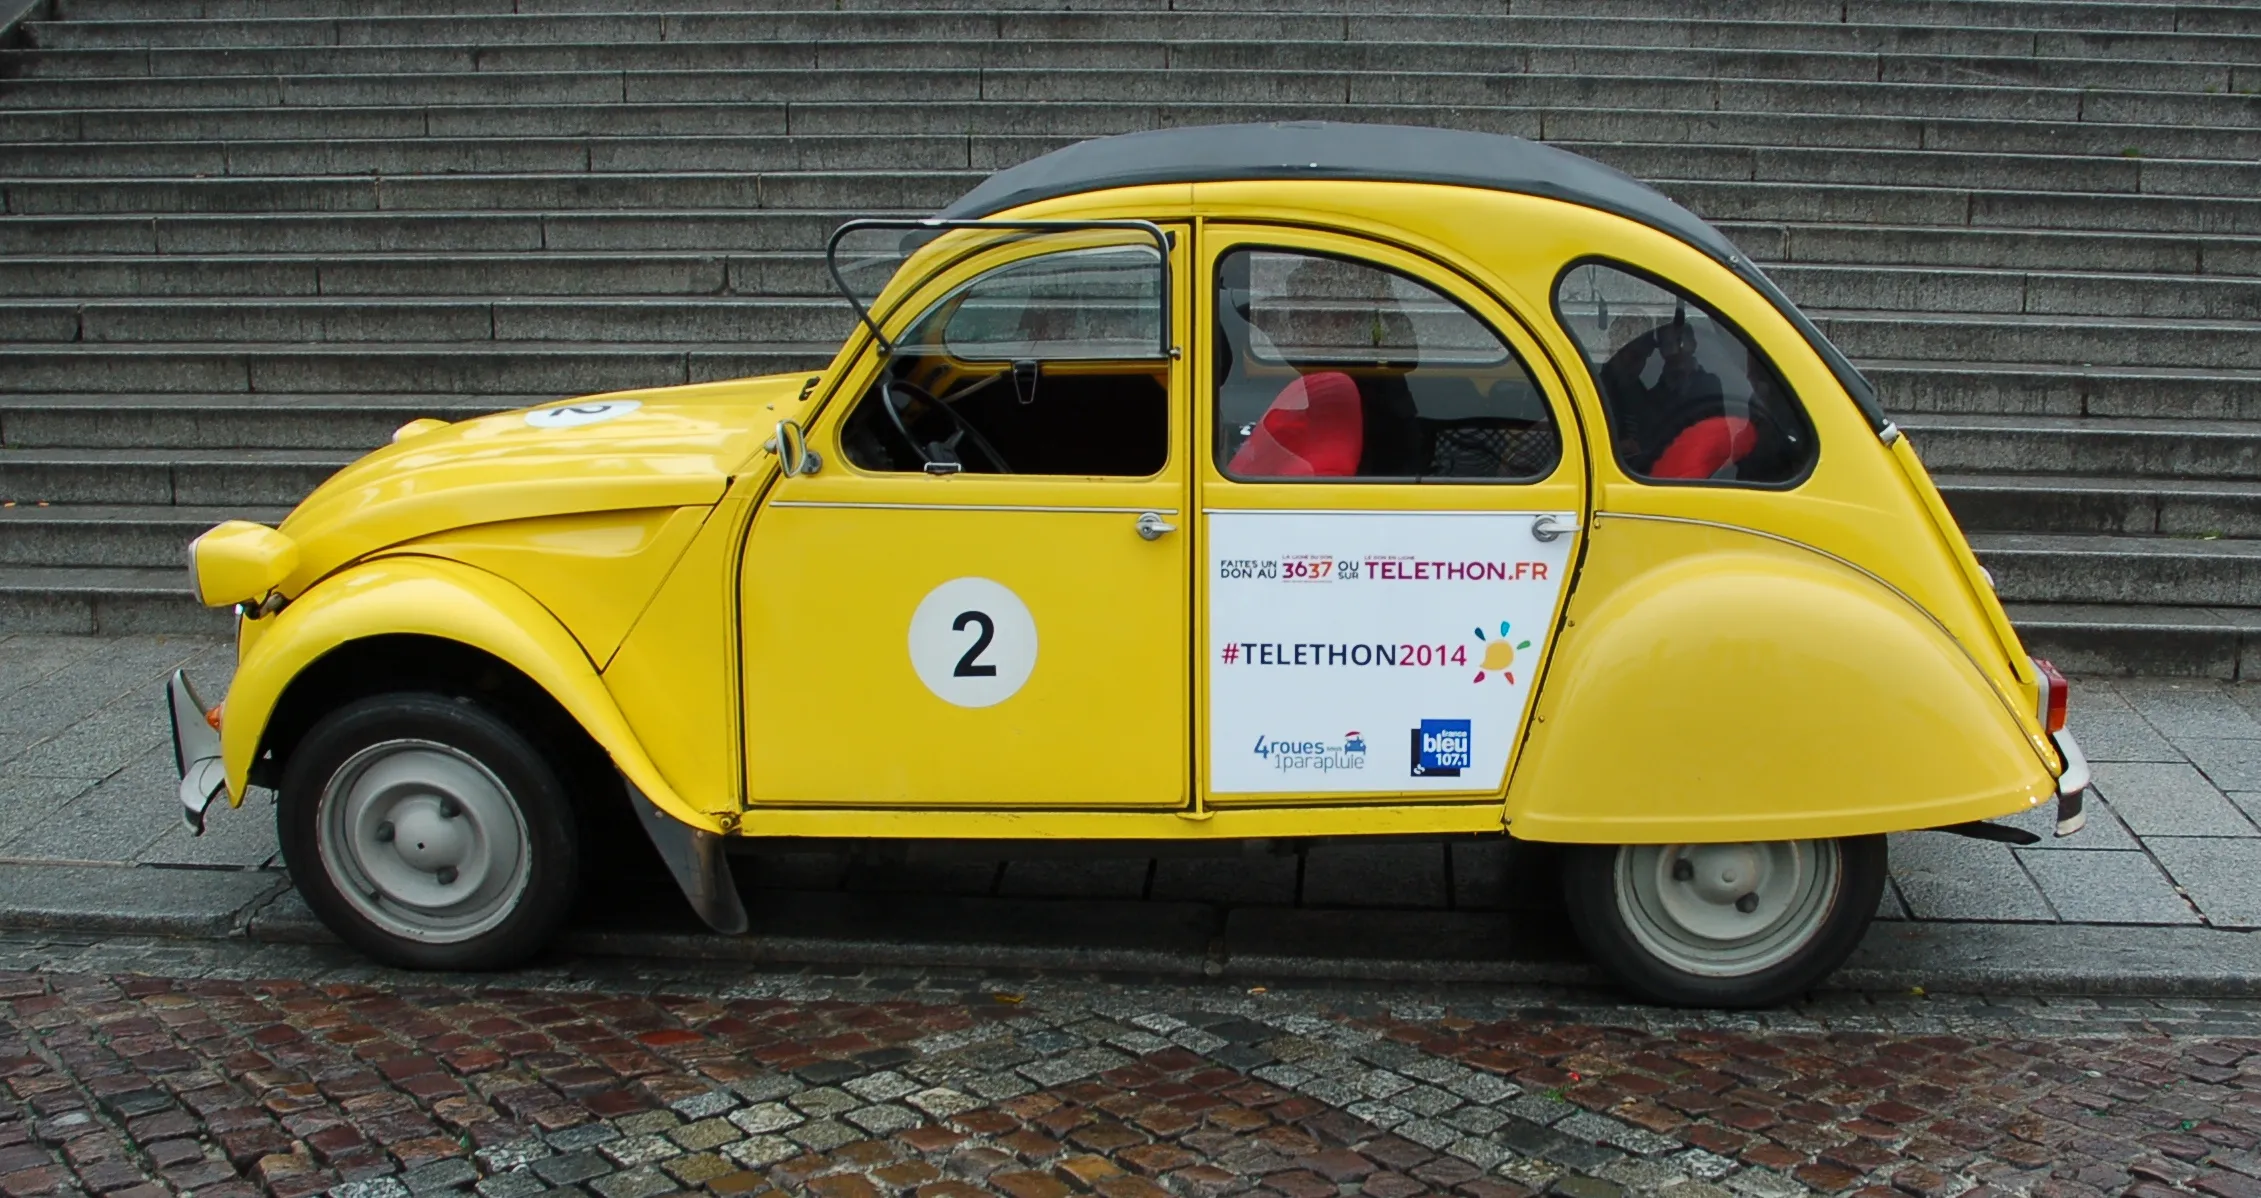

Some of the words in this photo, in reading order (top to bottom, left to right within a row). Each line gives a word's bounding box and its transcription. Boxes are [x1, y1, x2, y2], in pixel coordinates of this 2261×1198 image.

[1220, 560, 1258, 568] FAITES
[1261, 560, 1277, 568] UN
[1282, 561, 1333, 578] 3637
[1338, 560, 1359, 571] OU
[1365, 562, 1548, 580] TELETHON.FR
[1220, 568, 1252, 579] DON
[1257, 568, 1277, 579] AU
[1338, 571, 1359, 580] SUR
[952, 610, 997, 678] 2
[1222, 643, 1467, 666] #TELETHON2014
[1423, 732, 1468, 753] bleu
[1275, 752, 1365, 773] 1parapluie
[1435, 753, 1468, 766] 107.1
